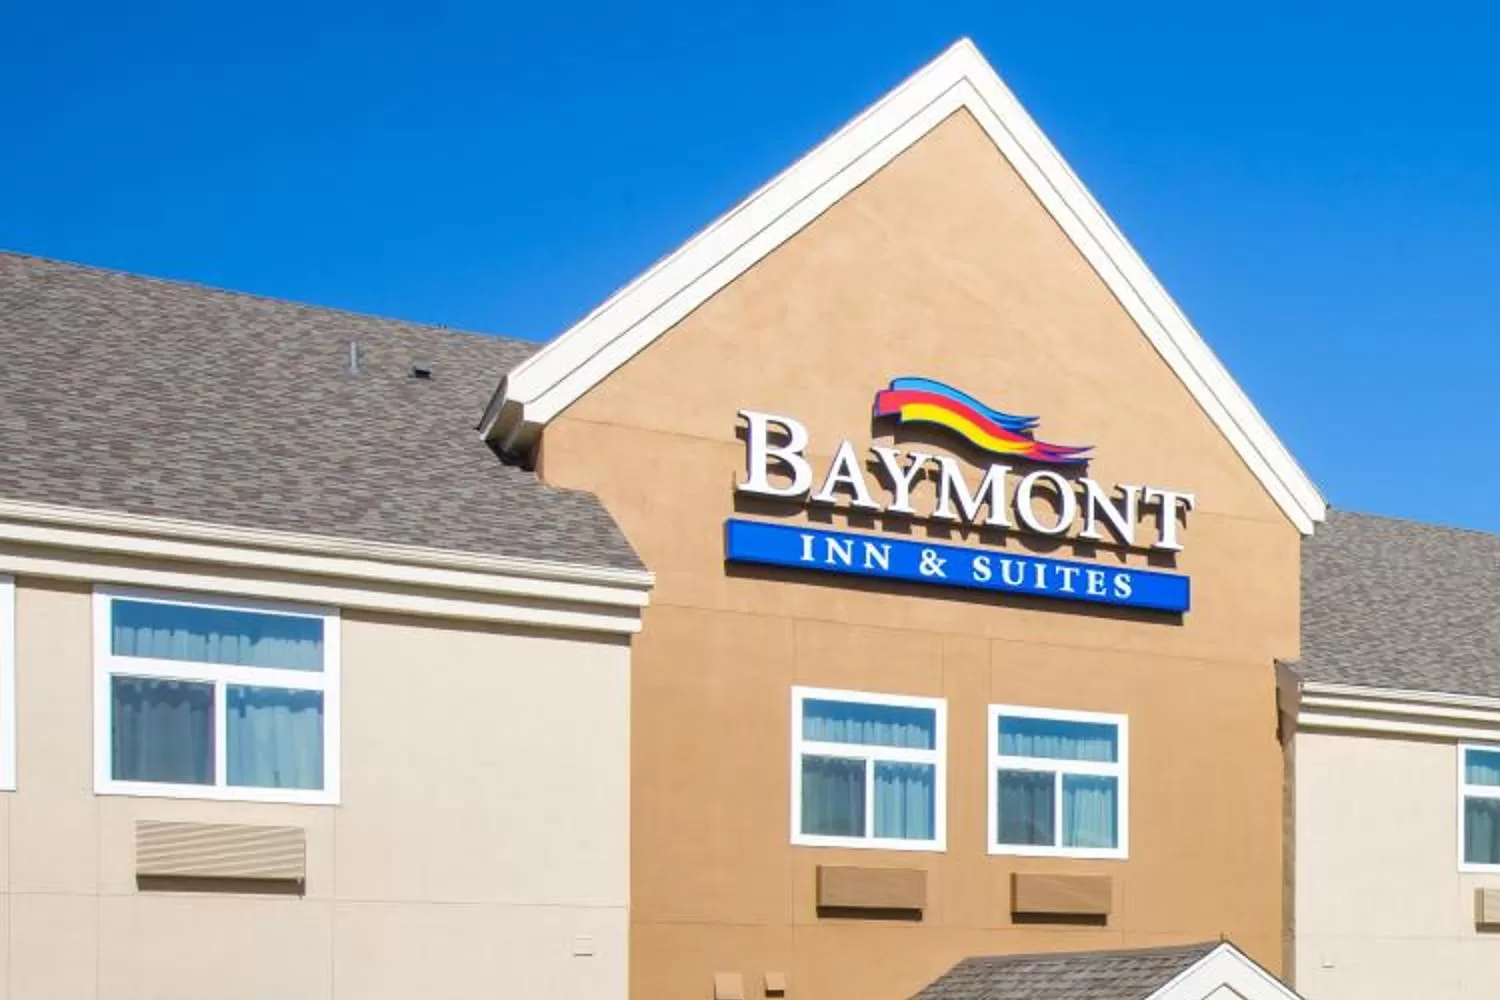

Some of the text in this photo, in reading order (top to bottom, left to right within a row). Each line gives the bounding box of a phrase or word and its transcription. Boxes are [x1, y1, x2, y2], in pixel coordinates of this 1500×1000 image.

[738, 409, 1195, 551] BAYMONT
[800, 534, 1133, 599] INN & SUITES
